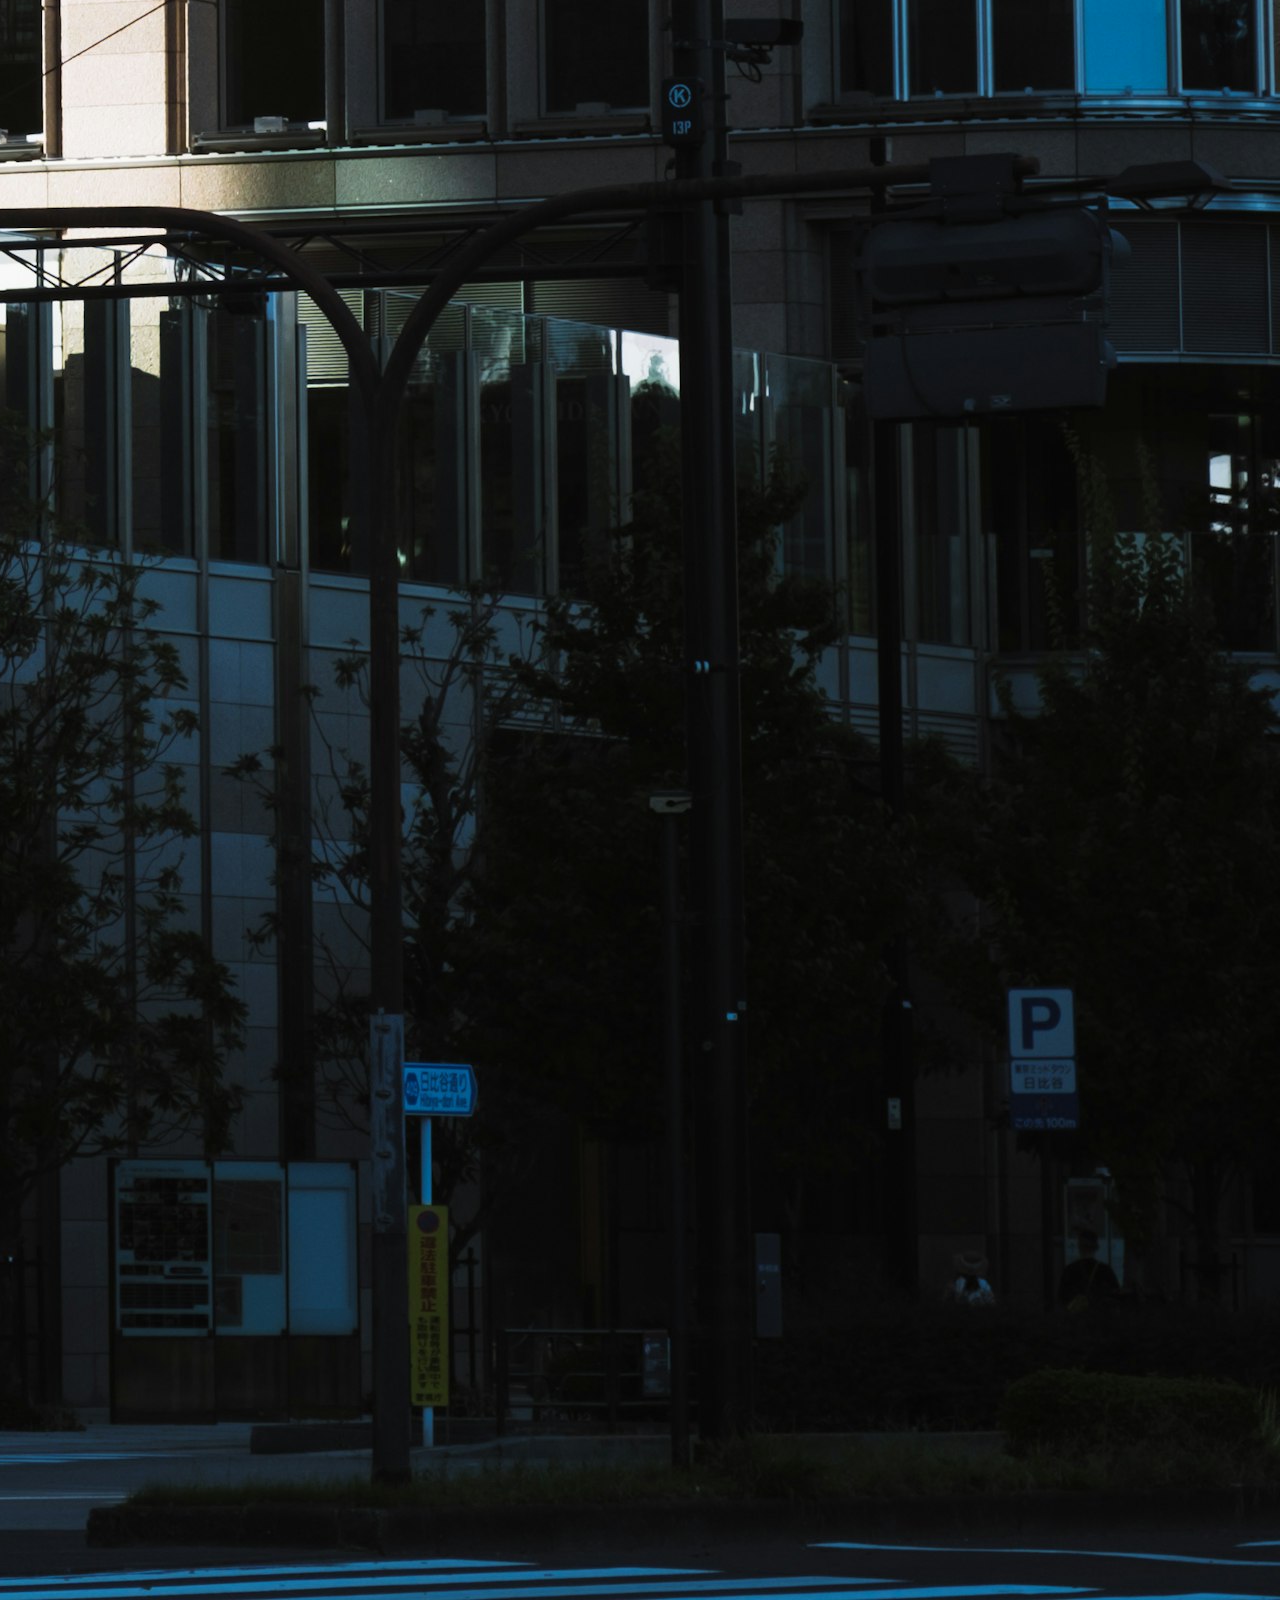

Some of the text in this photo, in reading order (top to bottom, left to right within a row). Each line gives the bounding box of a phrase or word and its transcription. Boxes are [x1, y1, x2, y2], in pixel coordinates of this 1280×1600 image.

[1021, 997, 1061, 1050] P
[421, 1071, 468, 1093] 日比谷通り
[1024, 1076, 1063, 1089] 日比谷
